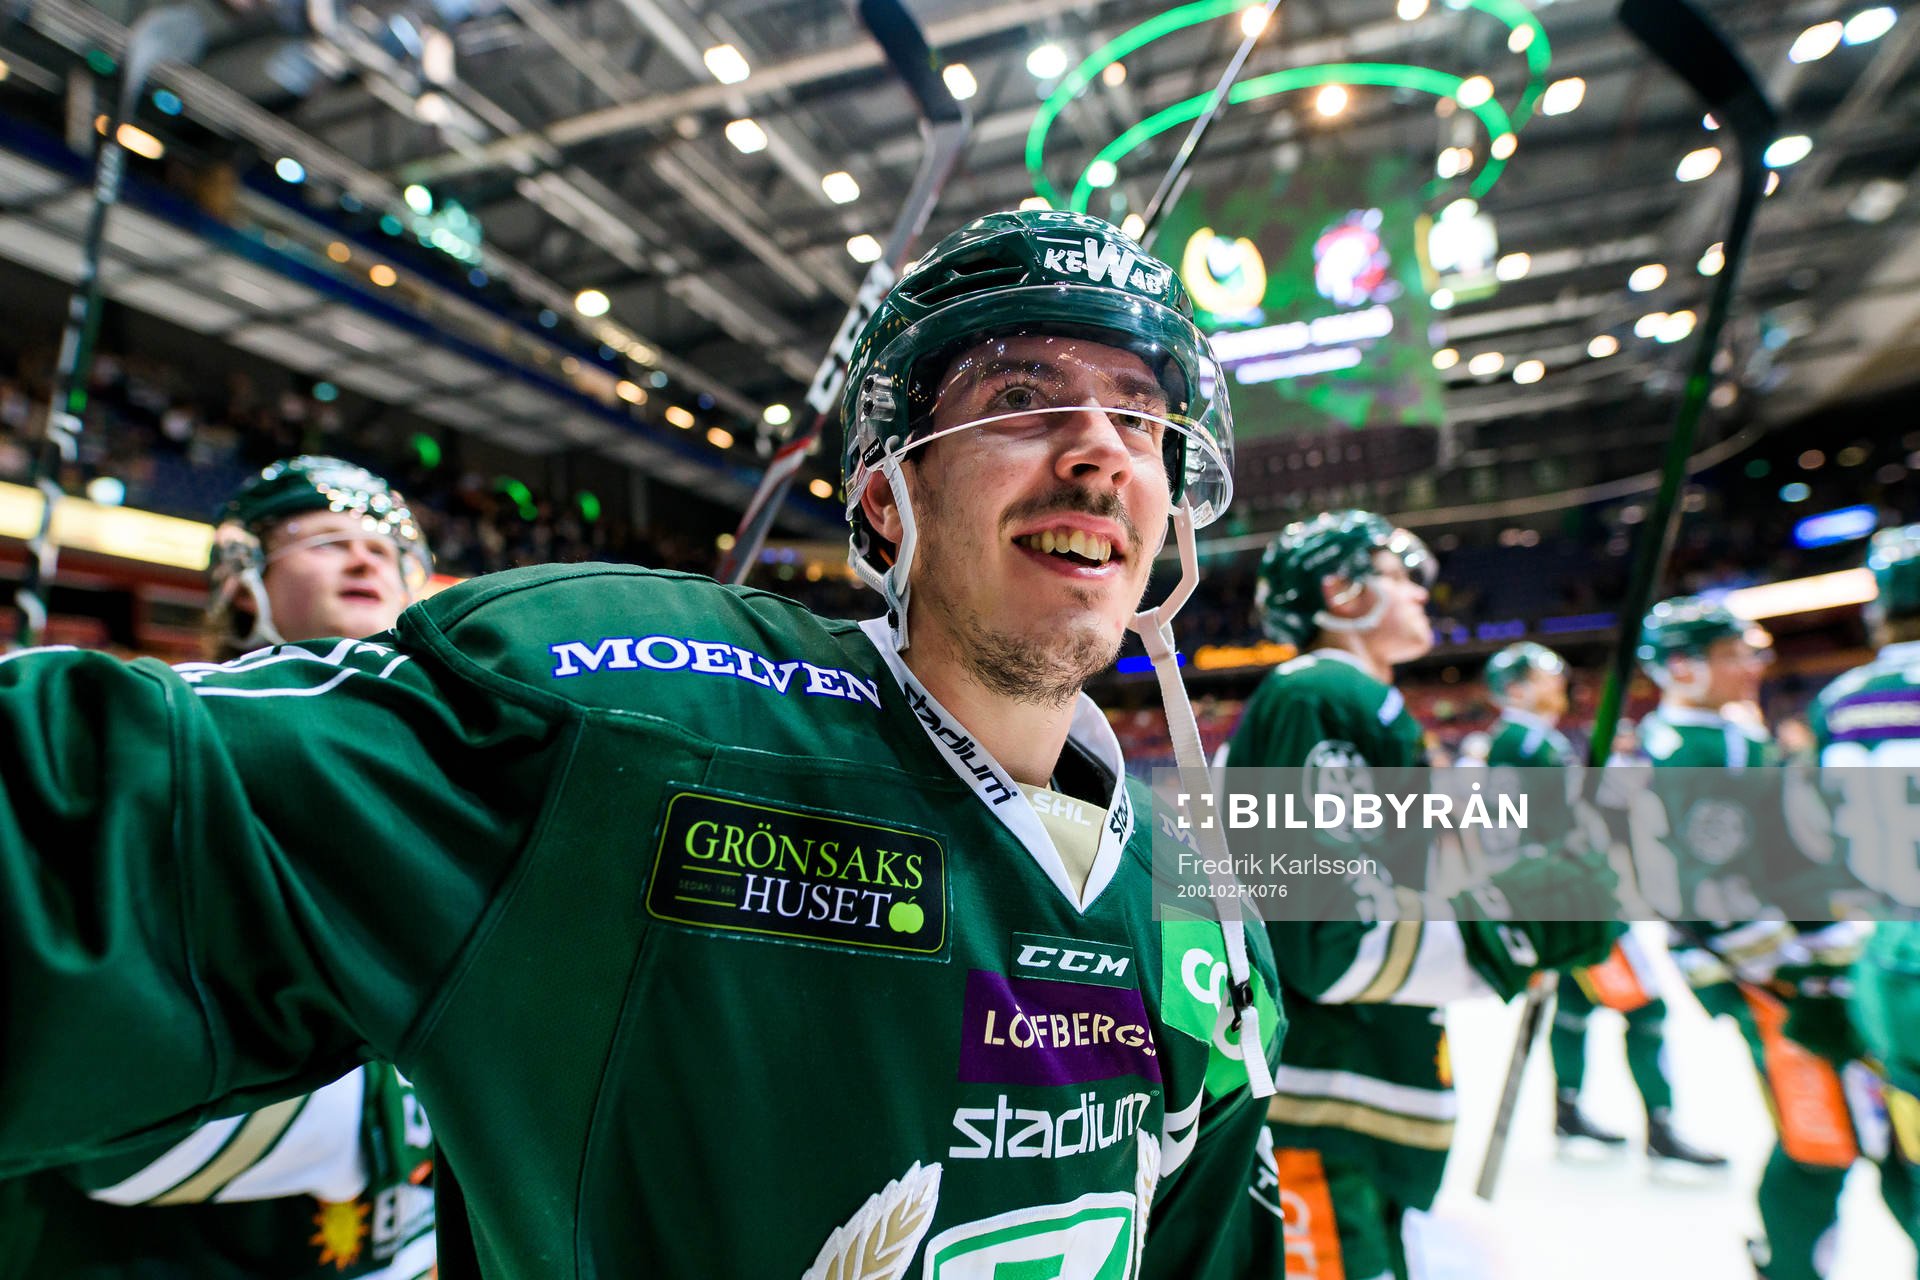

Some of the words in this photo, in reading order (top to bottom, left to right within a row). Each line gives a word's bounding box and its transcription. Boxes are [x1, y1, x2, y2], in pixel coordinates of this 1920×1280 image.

[863, 441, 880, 462] CCM
[550, 634, 883, 711] MOELVEN
[904, 681, 1012, 806] stadium
[1032, 792, 1092, 827] SHL
[684, 820, 923, 890] GRÖNSAKS
[739, 873, 892, 929] HUSET
[1016, 944, 1131, 978] CCM
[948, 1091, 1151, 1159] stadium
